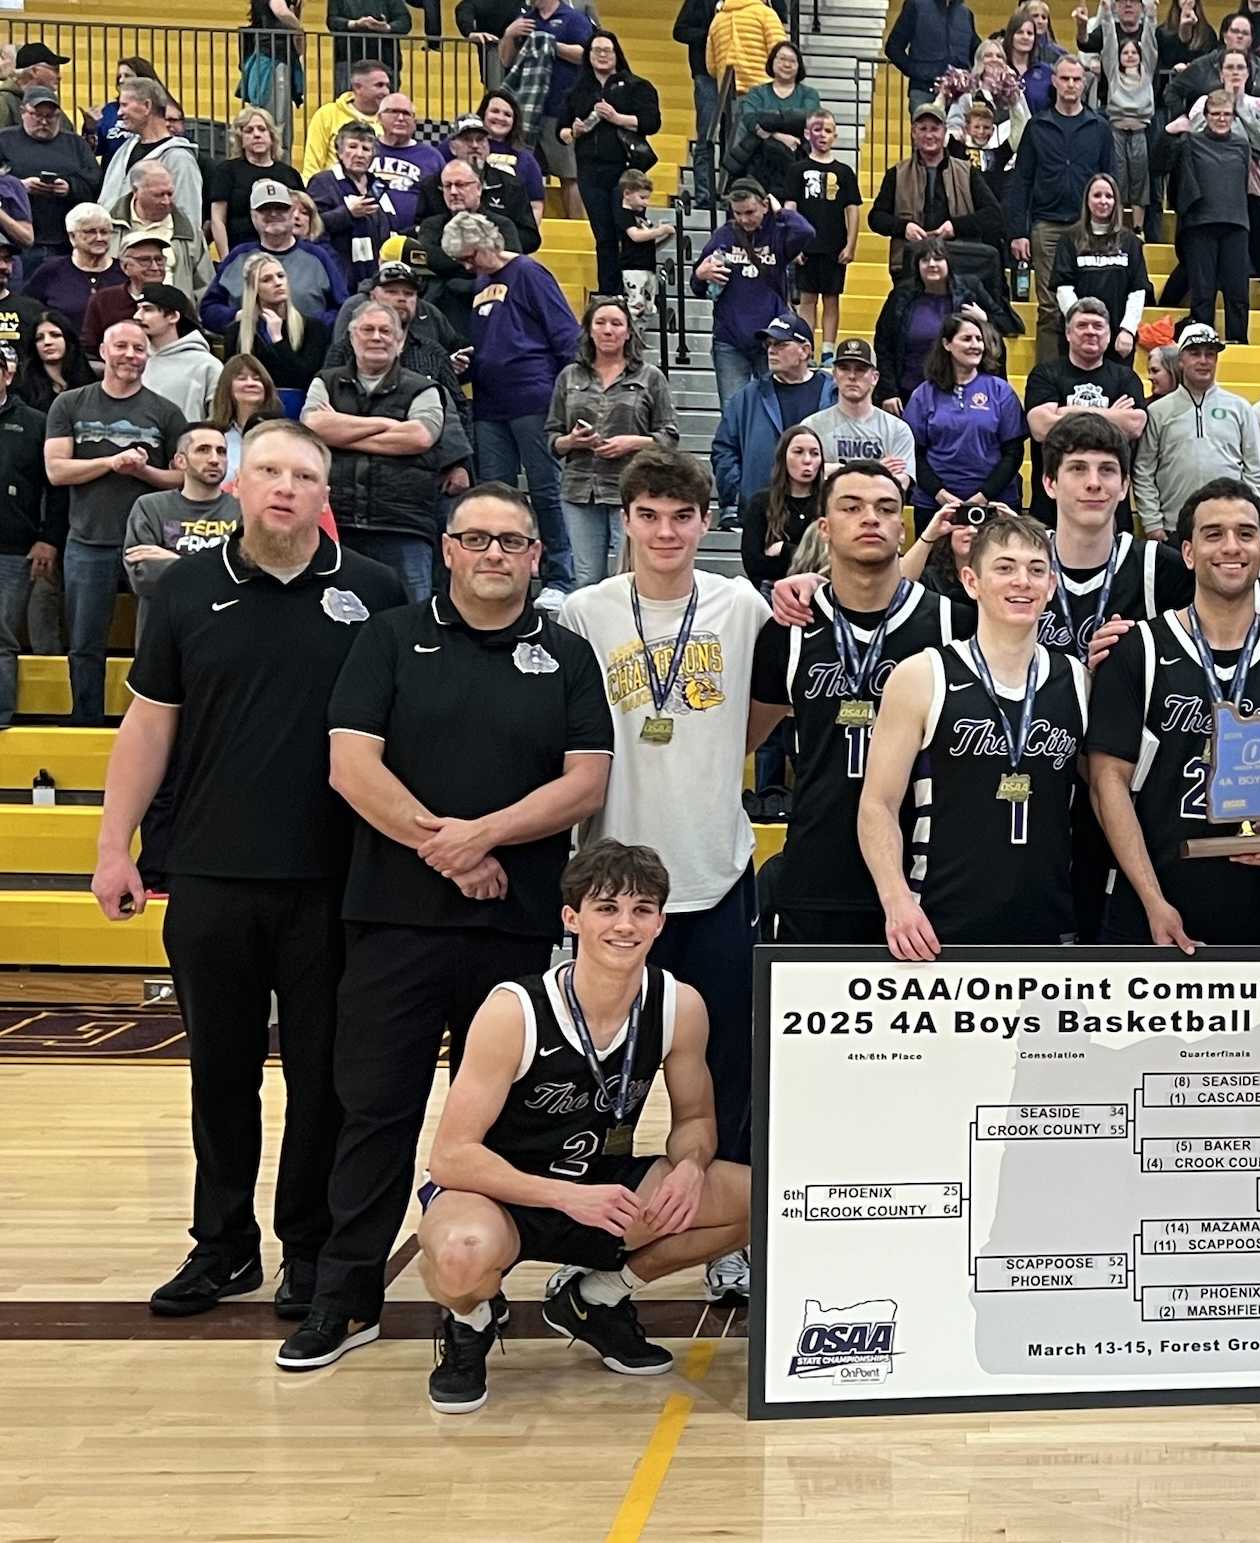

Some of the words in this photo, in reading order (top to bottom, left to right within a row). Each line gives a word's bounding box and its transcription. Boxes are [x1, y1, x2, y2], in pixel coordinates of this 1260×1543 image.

[368, 156, 421, 182] AKER
[837, 439, 883, 459] RINGS
[181, 519, 237, 537] TEAM
[949, 718, 1009, 757] The
[1022, 718, 1077, 770] City
[848, 977, 1111, 1000] OSAA/OnPoint
[783, 1011, 873, 1034] 2025
[890, 1011, 937, 1034] 4A
[954, 1011, 1040, 1039] Boys
[1058, 1009, 1250, 1033] Basketball
[891, 1052, 923, 1061] Place
[1019, 1050, 1086, 1060] Consolation
[1179, 1049, 1251, 1059] Quarterfinals
[1173, 1075, 1191, 1089] (8)
[1201, 1075, 1260, 1088] SEASIDE
[524, 1082, 590, 1114] The
[1169, 1092, 1187, 1107] (1)
[1019, 1106, 1081, 1119] SEASIDE
[1109, 1106, 1125, 1118] 34
[986, 1123, 1039, 1137] CROOK
[1042, 1122, 1102, 1136] COUNTY
[1109, 1124, 1126, 1136] 55
[549, 1130, 599, 1177] 2
[1175, 1140, 1193, 1154] (5)
[1203, 1139, 1252, 1152] BAKER
[1146, 1157, 1164, 1171] (4)
[1174, 1156, 1225, 1169] CROOK
[782, 1188, 805, 1201] 6th
[828, 1187, 893, 1199] PHOENIX
[942, 1185, 959, 1197] 25
[780, 1207, 803, 1219] 4th
[808, 1205, 863, 1219] CROOK
[866, 1204, 928, 1218] COUNTY
[942, 1203, 959, 1215] 64
[1164, 1222, 1190, 1236] (14)
[1200, 1220, 1260, 1233] MAZAMA
[1153, 1239, 1177, 1254] (11)
[1005, 1257, 1094, 1271] SCAPPOOSE
[1108, 1255, 1124, 1268] 52
[1010, 1274, 1074, 1288] PHOENIX
[1109, 1273, 1124, 1285] 71
[1171, 1287, 1190, 1302] (7)
[1158, 1305, 1176, 1320] (2)
[799, 1323, 896, 1356] OSAA
[1027, 1342, 1087, 1357] March
[1094, 1341, 1152, 1356] 13-15,
[1159, 1338, 1221, 1353] Forest
[796, 1356, 822, 1366] STATE
[822, 1354, 890, 1365] CHAMPIONSHIPS
[840, 1367, 880, 1379] OnPoint
